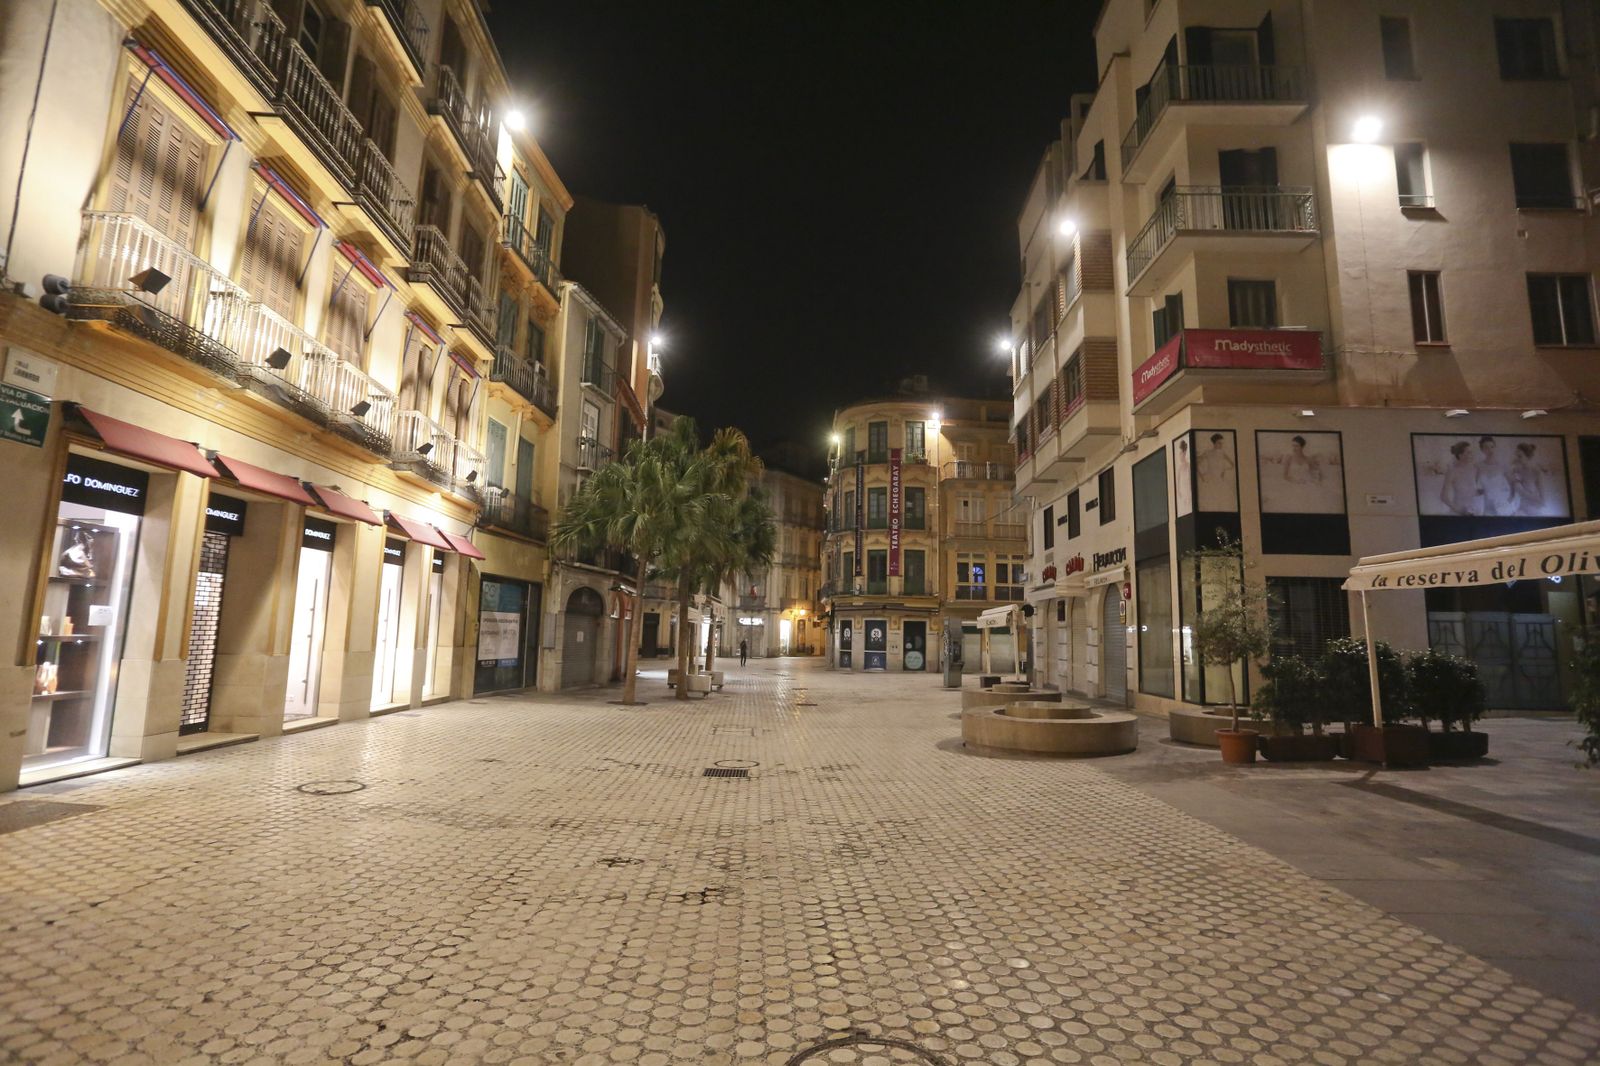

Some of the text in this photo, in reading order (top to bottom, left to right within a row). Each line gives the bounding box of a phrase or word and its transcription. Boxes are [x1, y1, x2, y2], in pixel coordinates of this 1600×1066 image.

[16, 391, 28, 400] DE
[84, 478, 140, 498] DOMINGUEZ
[891, 465, 900, 550] TEATRO ECHEGARAY
[1396, 569, 1480, 587] reserva
[1491, 558, 1527, 580] del
